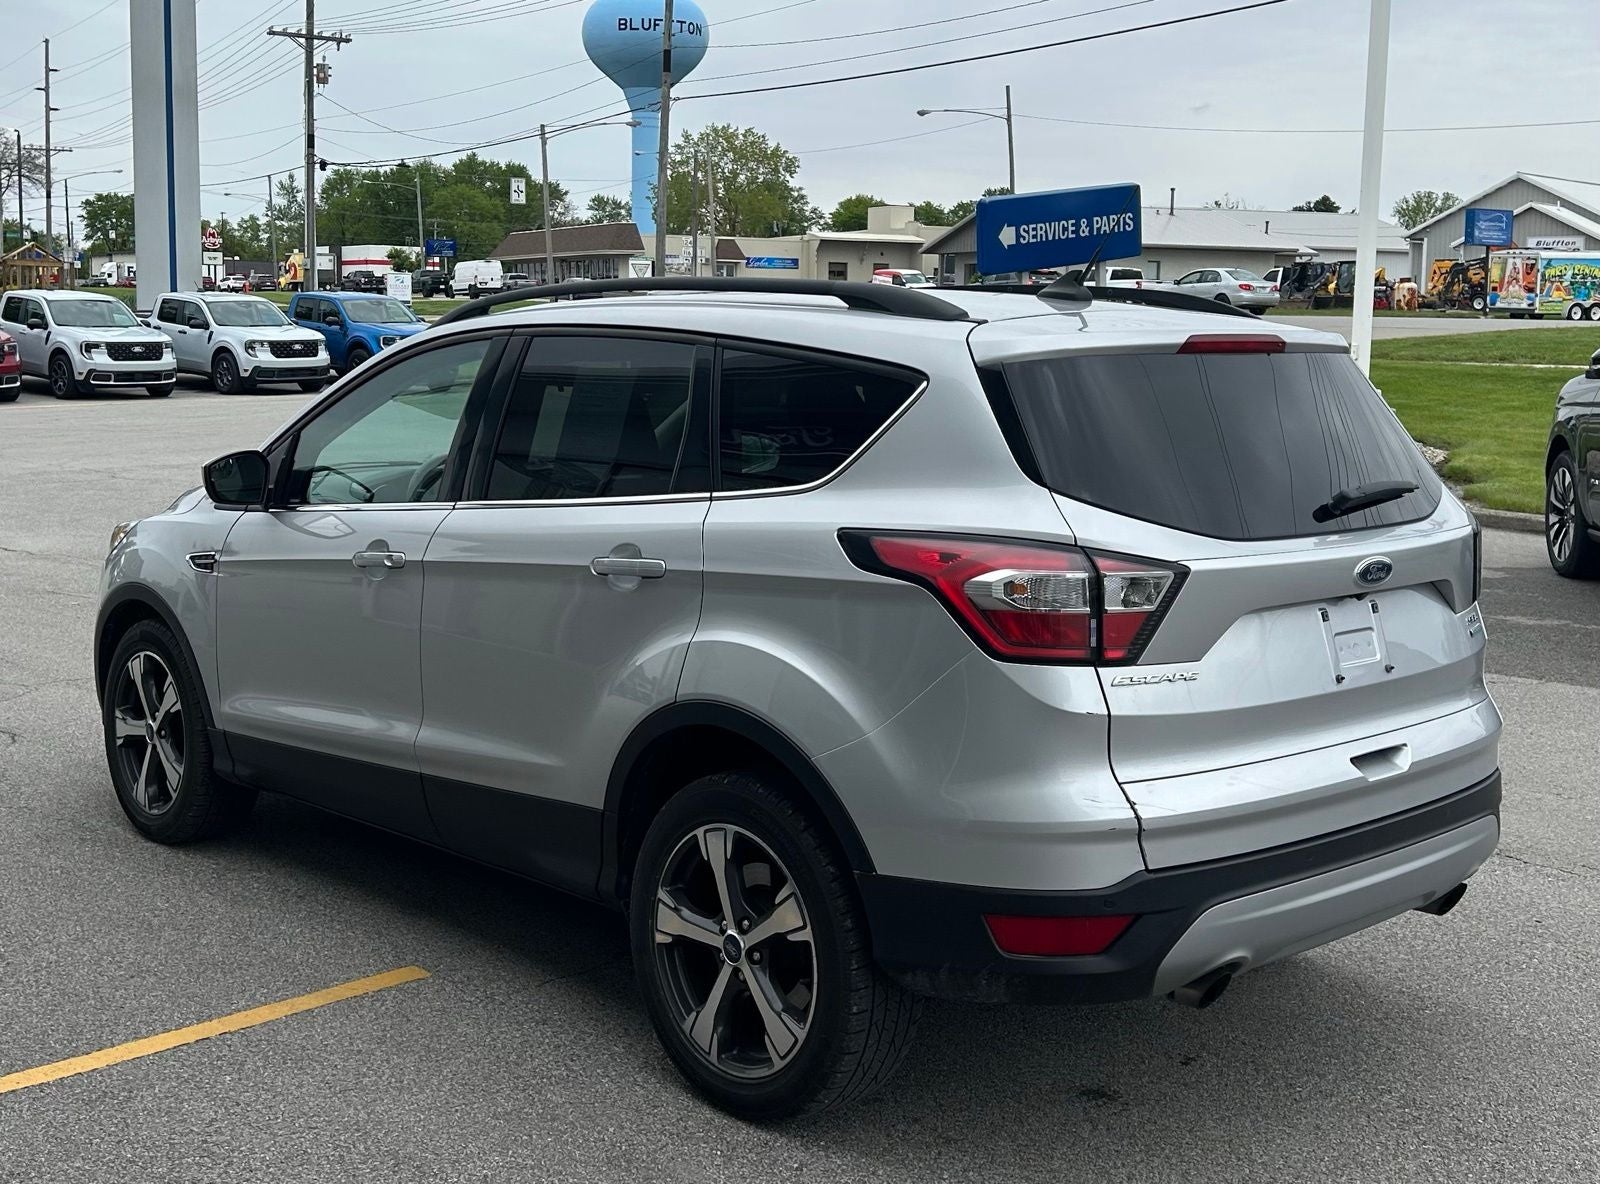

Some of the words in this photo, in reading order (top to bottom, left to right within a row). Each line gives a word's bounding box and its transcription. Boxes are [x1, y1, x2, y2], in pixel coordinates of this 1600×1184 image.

[618, 17, 702, 36] BLUFTON
[1020, 219, 1076, 244] SERVICE
[1080, 218, 1090, 237] &
[1093, 213, 1134, 235] PARTS
[1535, 239, 1577, 247] Bluffton
[1111, 671, 1200, 687] ESCAPE
